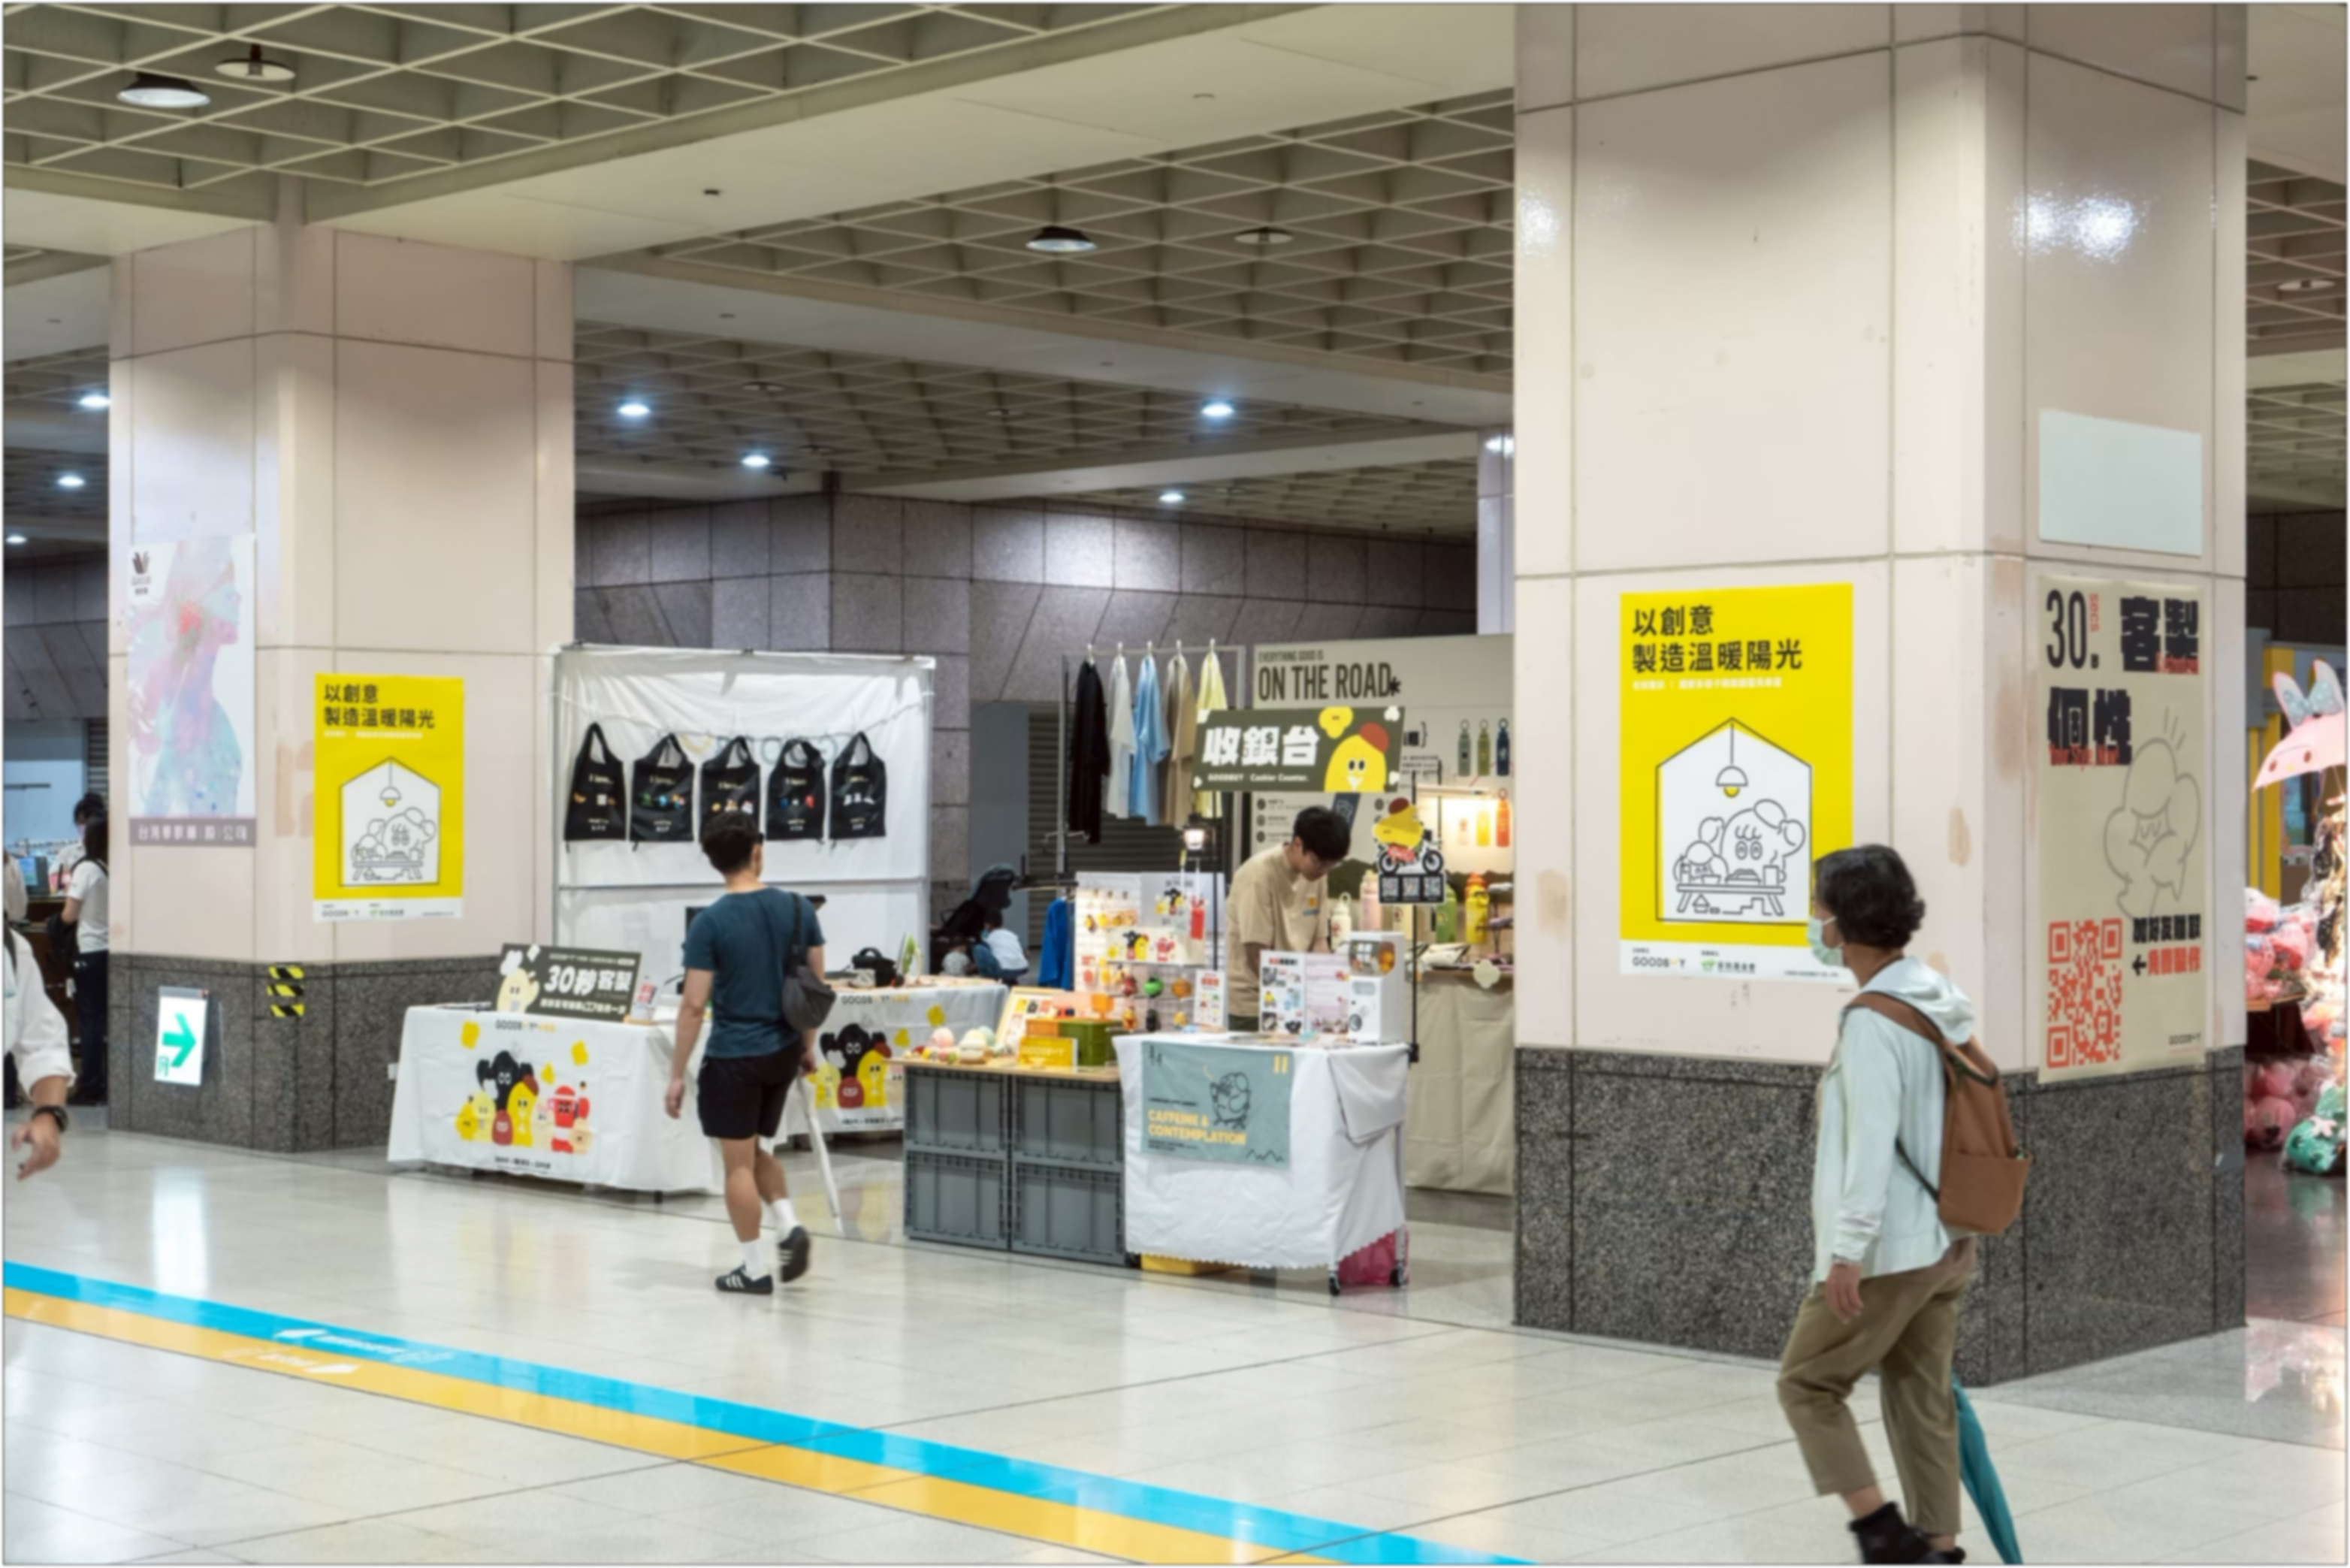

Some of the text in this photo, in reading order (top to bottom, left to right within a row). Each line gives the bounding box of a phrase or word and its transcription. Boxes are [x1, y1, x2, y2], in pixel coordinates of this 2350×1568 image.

[1633, 604, 1714, 637] 以創意
[1258, 649, 1324, 663] EVERYTHING GOOD IS
[1633, 638, 1803, 674] 製造溫暖陽光
[324, 684, 379, 704] 以創意
[1258, 666, 1285, 702] ON
[1291, 664, 1330, 700] THE
[323, 706, 436, 730] 製造溫暖陽光
[1202, 725, 1320, 767] 收銀台
[1207, 772, 1244, 782] GOODBUY
[1250, 772, 1276, 782] Cashier
[1147, 1109, 1210, 1127] CAFFEINE &
[1147, 1122, 1247, 1147] CONTEMPLATION
